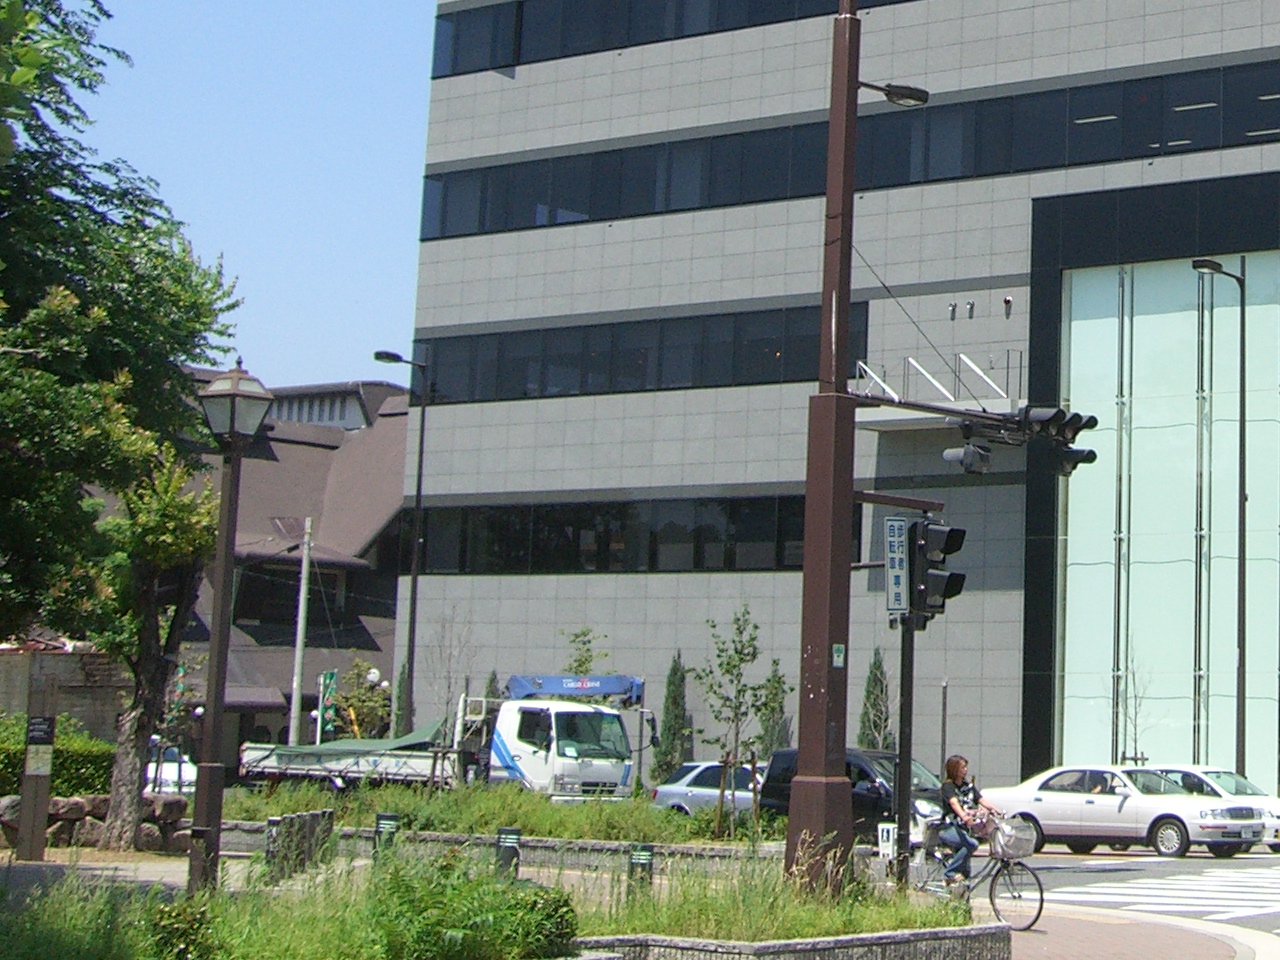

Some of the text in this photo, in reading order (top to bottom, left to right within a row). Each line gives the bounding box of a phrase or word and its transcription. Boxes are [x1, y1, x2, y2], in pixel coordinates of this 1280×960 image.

[888, 524, 896, 570] 自転車
[897, 524, 905, 571] 歩行者
[893, 574, 902, 606] 専用
